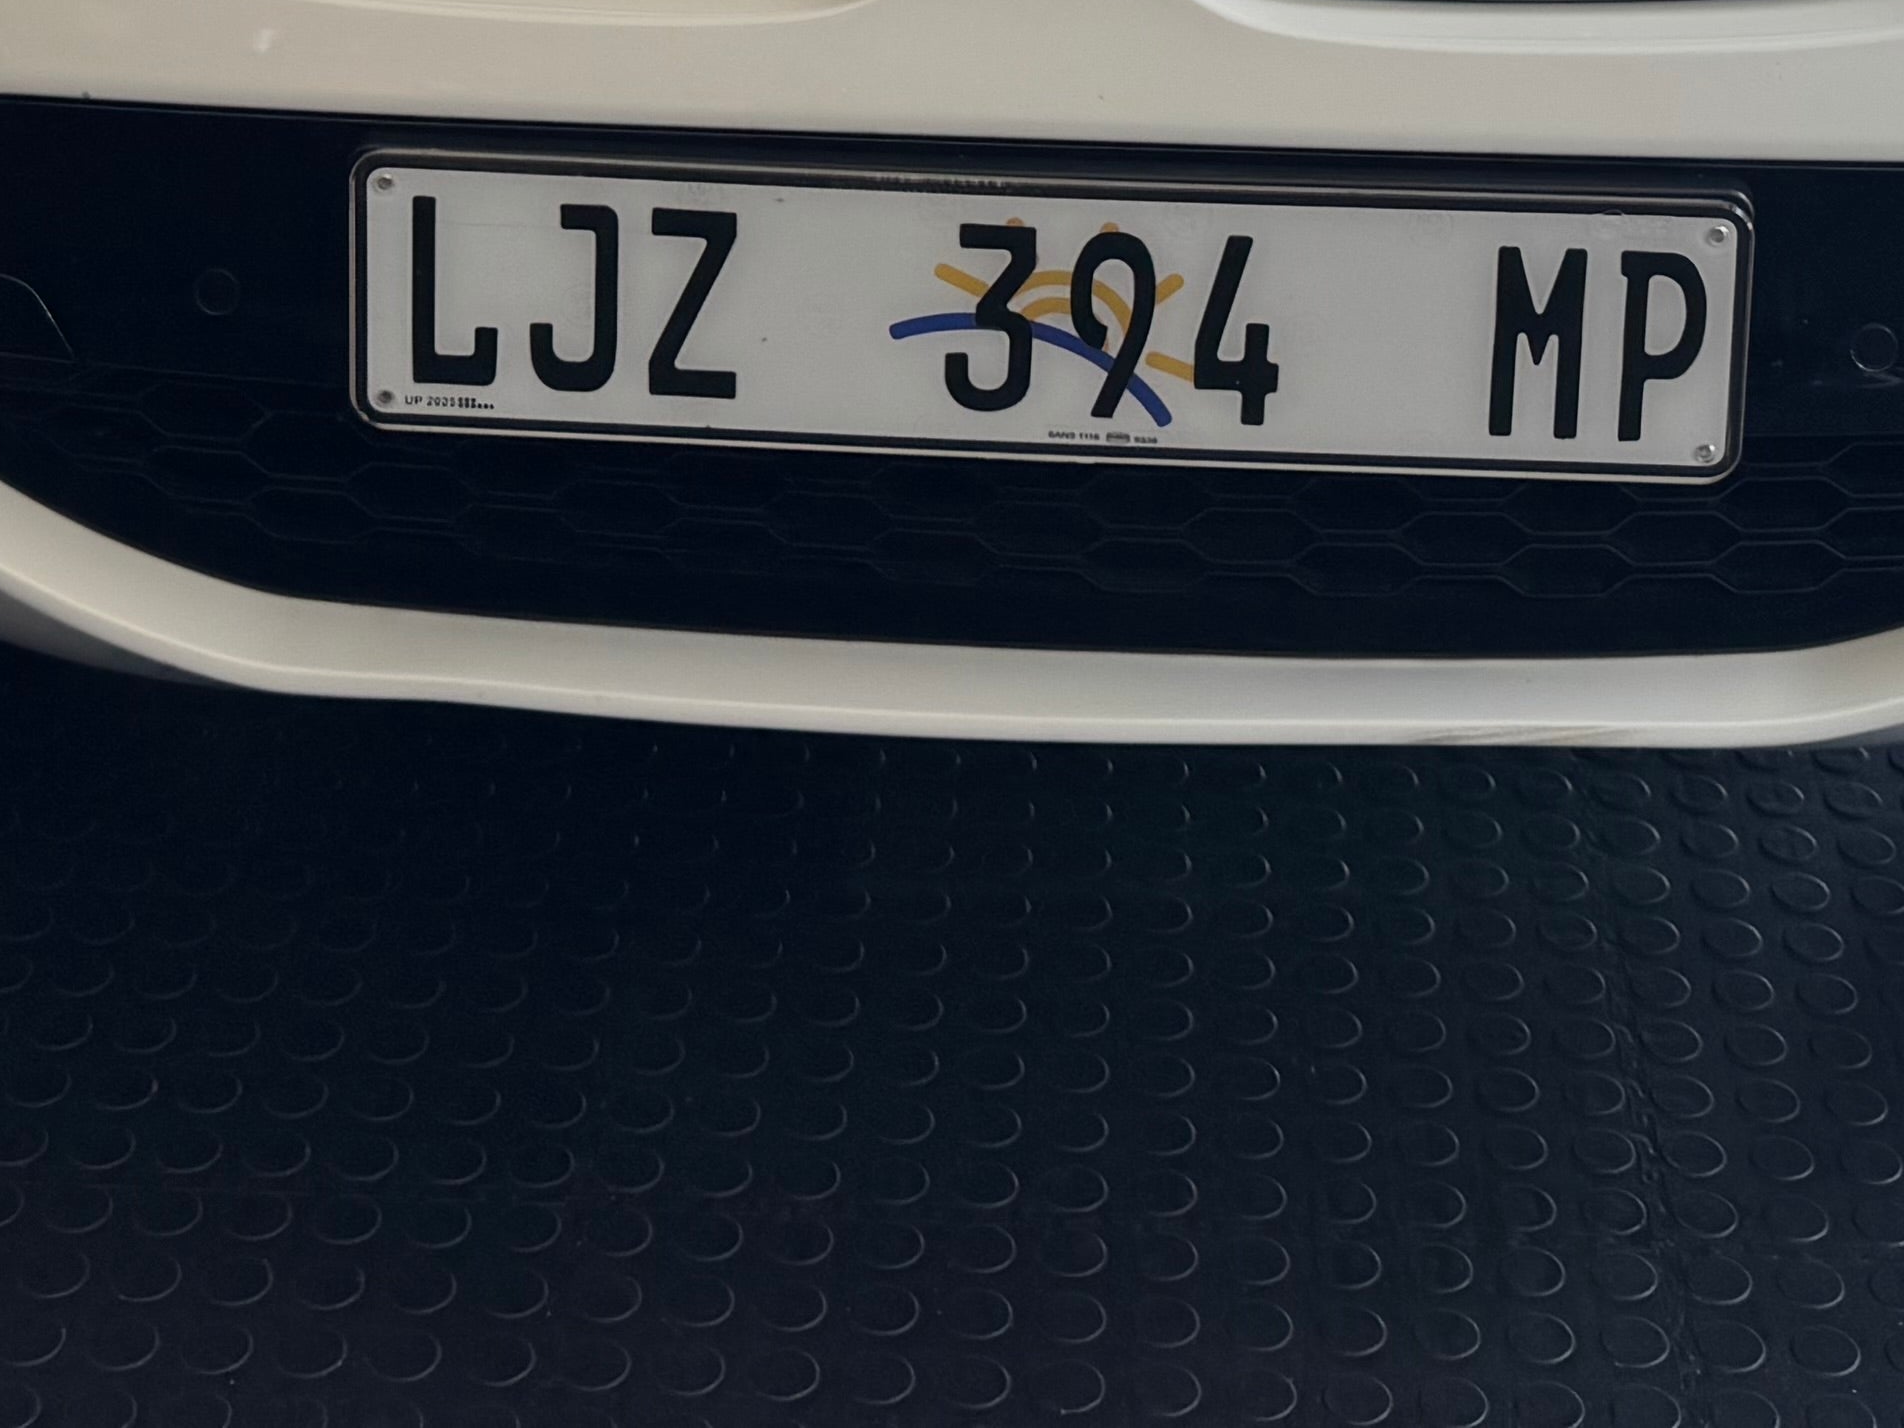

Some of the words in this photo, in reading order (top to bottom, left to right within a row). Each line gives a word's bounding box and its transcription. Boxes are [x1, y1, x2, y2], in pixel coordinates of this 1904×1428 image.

[411, 195, 738, 400] LJZ
[943, 223, 1278, 426] 394
[1488, 244, 1706, 443] MP
